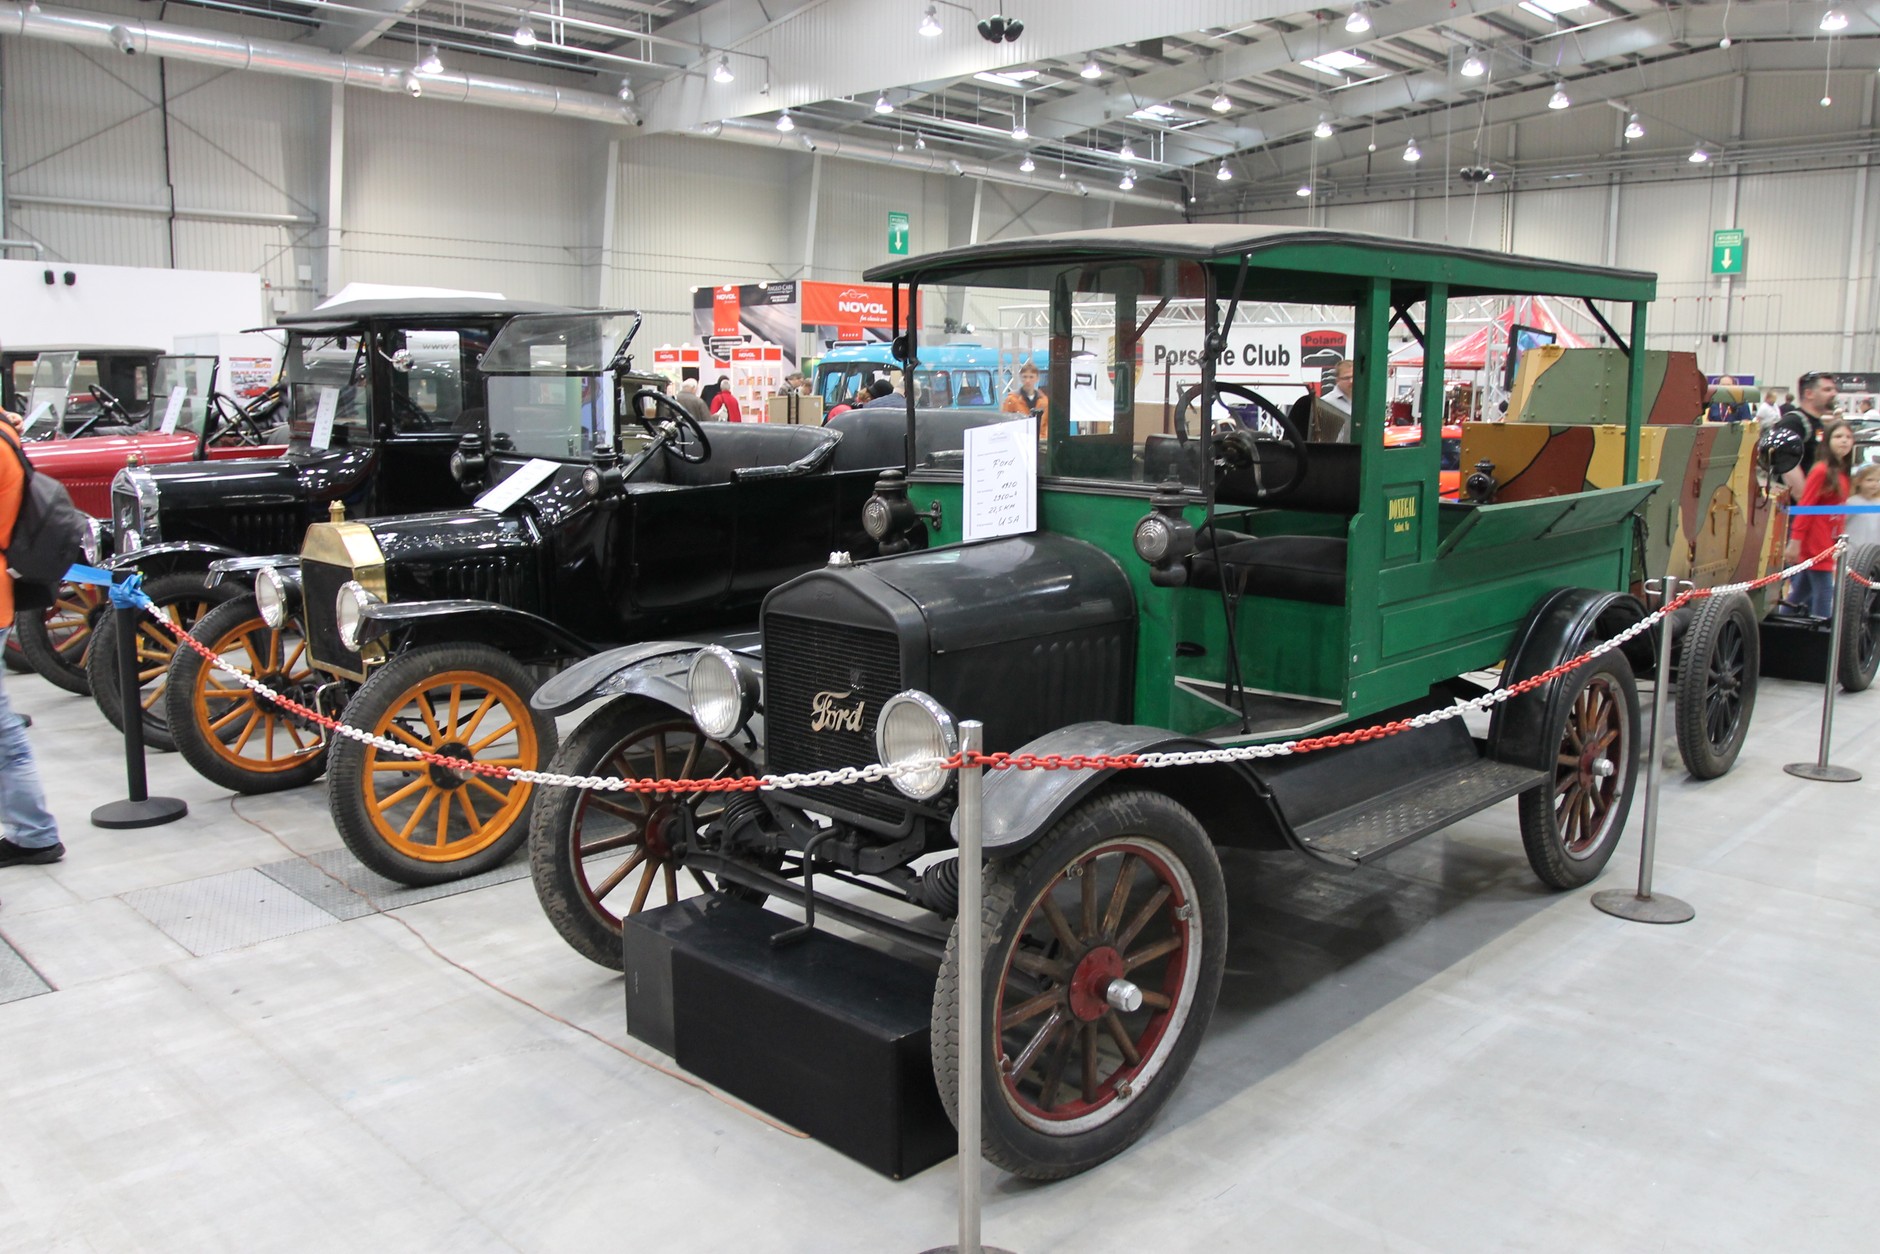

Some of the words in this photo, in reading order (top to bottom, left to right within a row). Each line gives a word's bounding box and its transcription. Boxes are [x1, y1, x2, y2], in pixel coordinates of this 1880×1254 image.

[838, 301, 888, 314] NOVOL
[1305, 335, 1344, 344] Poland
[1242, 344, 1290, 366] Club
[811, 690, 865, 732] Ford
